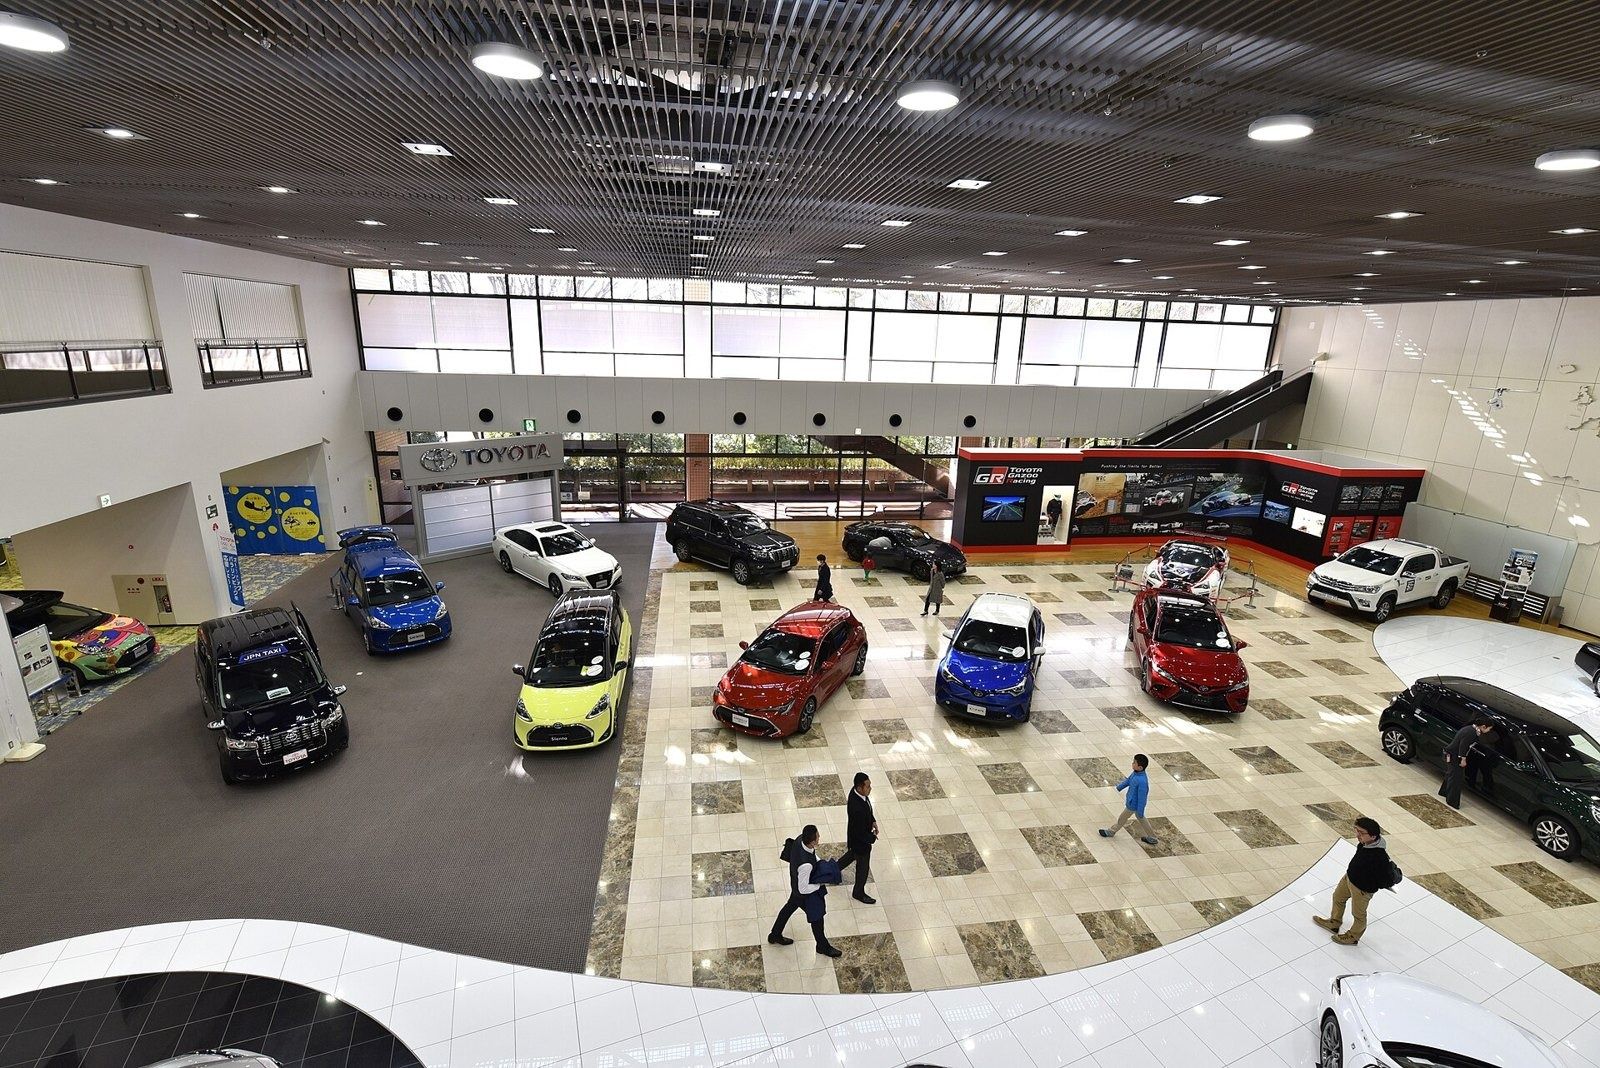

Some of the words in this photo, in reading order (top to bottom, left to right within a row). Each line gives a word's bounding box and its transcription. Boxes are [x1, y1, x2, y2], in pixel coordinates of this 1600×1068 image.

[461, 443, 551, 466] TOYOTA
[975, 473, 1005, 483] GR
[1515, 557, 1524, 566] 5
[243, 652, 261, 661] JPN
[262, 647, 282, 656] TAXI
